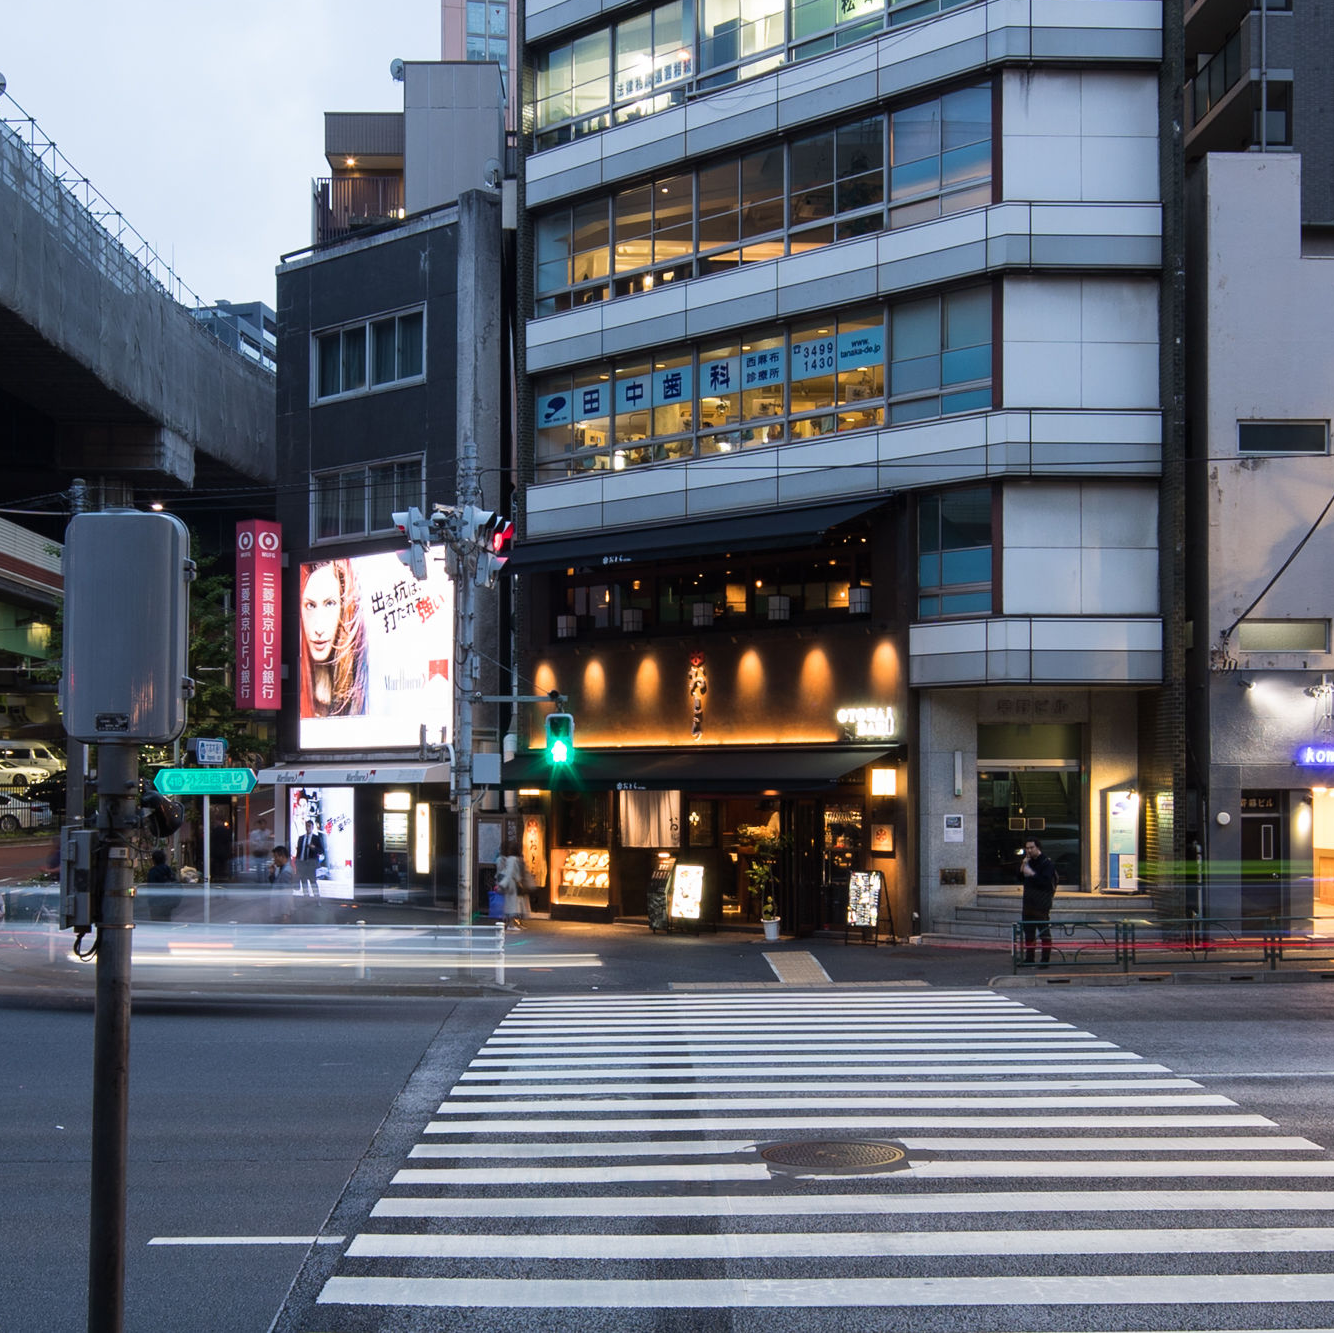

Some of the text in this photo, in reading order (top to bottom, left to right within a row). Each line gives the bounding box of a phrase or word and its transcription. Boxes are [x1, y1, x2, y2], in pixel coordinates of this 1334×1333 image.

[803, 342, 833, 358] 3499
[746, 352, 779, 368] 西麻布
[804, 356, 833, 372] 1430
[583, 362, 731, 415] 田中歯科
[241, 572, 251, 699] 三菱東京UFJ銀行
[262, 572, 275, 699] 三菱東京UFJ銀行
[168, 772, 244, 786] 418 外苑西通り
